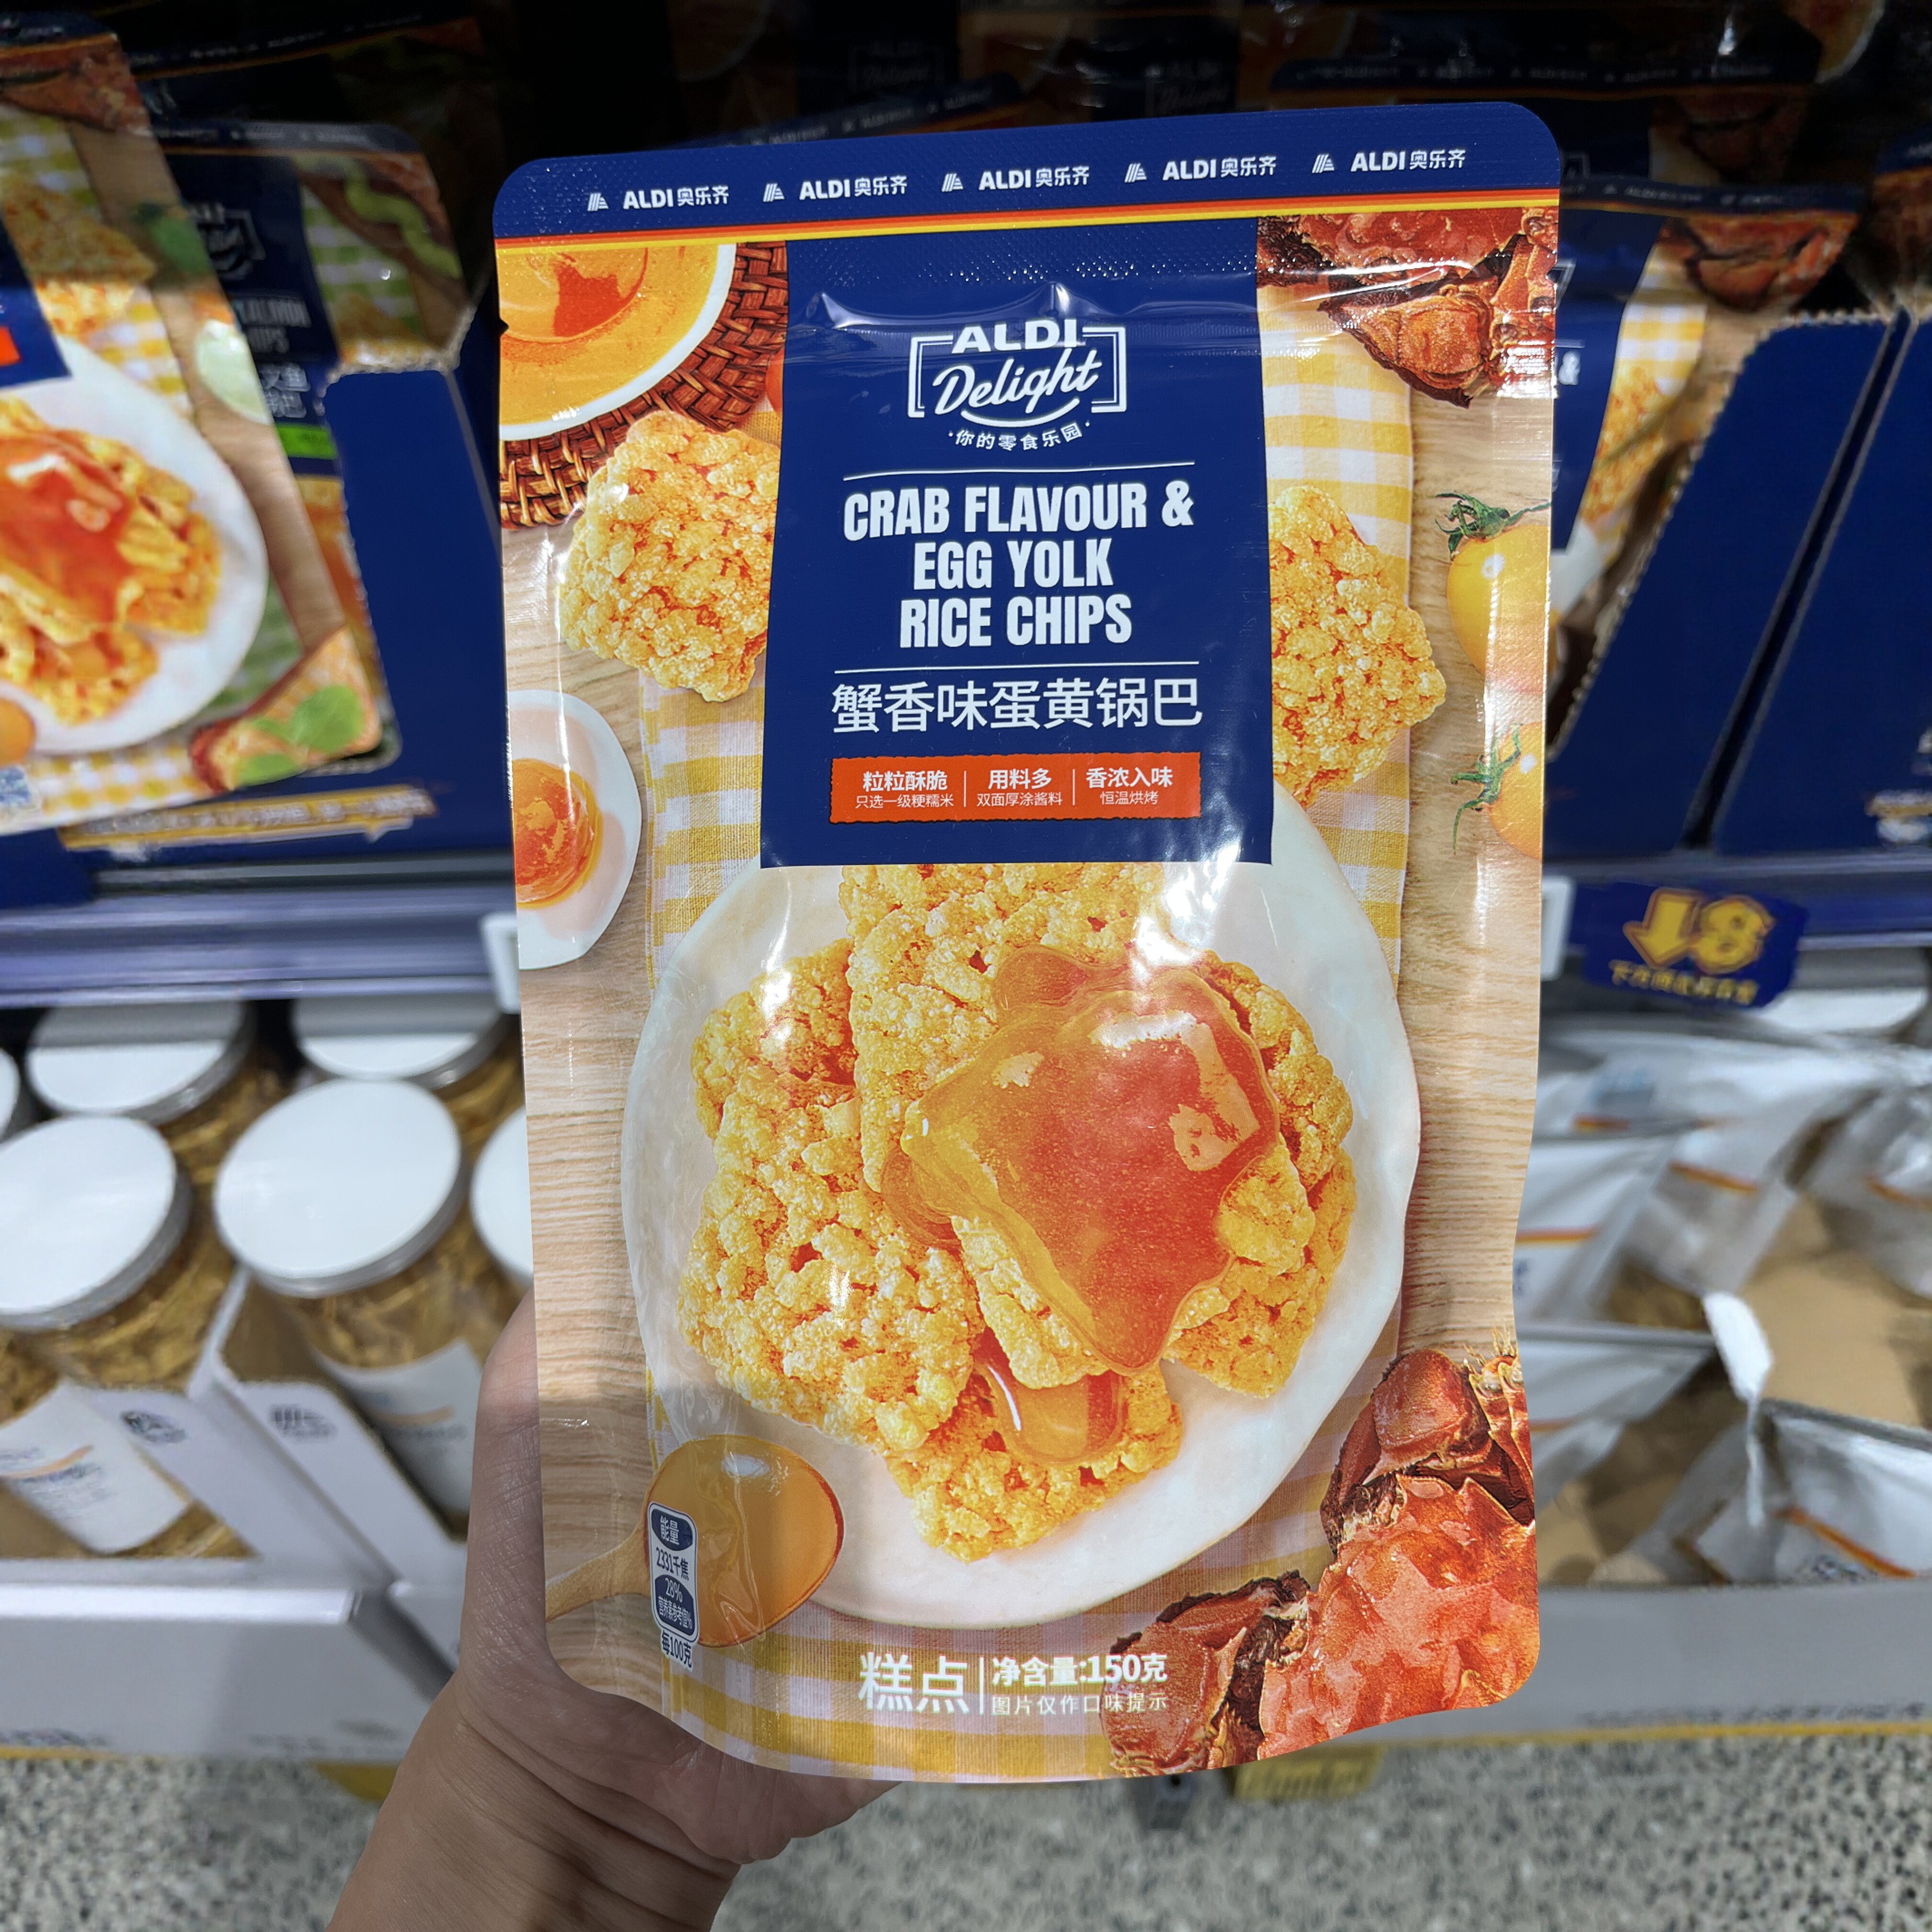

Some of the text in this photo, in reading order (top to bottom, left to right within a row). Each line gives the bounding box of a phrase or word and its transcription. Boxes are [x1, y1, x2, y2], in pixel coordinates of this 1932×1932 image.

[1162, 156, 1276, 181] ALDI 奥乐齐
[1351, 149, 1466, 172] ALDI 奥乐齐
[799, 175, 907, 201] ALDI 奥乐齐
[979, 165, 1090, 191] ALDI 奥乐齐
[623, 185, 729, 210] ALDI 奥乐齐
[952, 319, 1077, 354] ALDI
[932, 348, 1103, 415] Delight
[954, 422, 1083, 451] 你的零食乐园
[843, 480, 1195, 542] CRAB FLAVOUR &
[913, 538, 1114, 591] EGG YOLK
[899, 594, 1133, 649] RICE CHIPS
[831, 677, 1203, 734] 蟹香味蛋黄锅巴
[862, 770, 948, 792] 粒粒酥脆
[988, 768, 1052, 790] 用料多
[1086, 766, 1173, 789] 香浓入味
[855, 794, 954, 809] 只选一级粳糯米
[976, 792, 1063, 807] 双面厚涂酱料
[1100, 791, 1159, 805] 恒温烘烤
[858, 1651, 969, 1714] 糕点
[992, 1653, 1168, 1687] 净含量:150克
[990, 1692, 1168, 1717] 图片仅作口味提示
